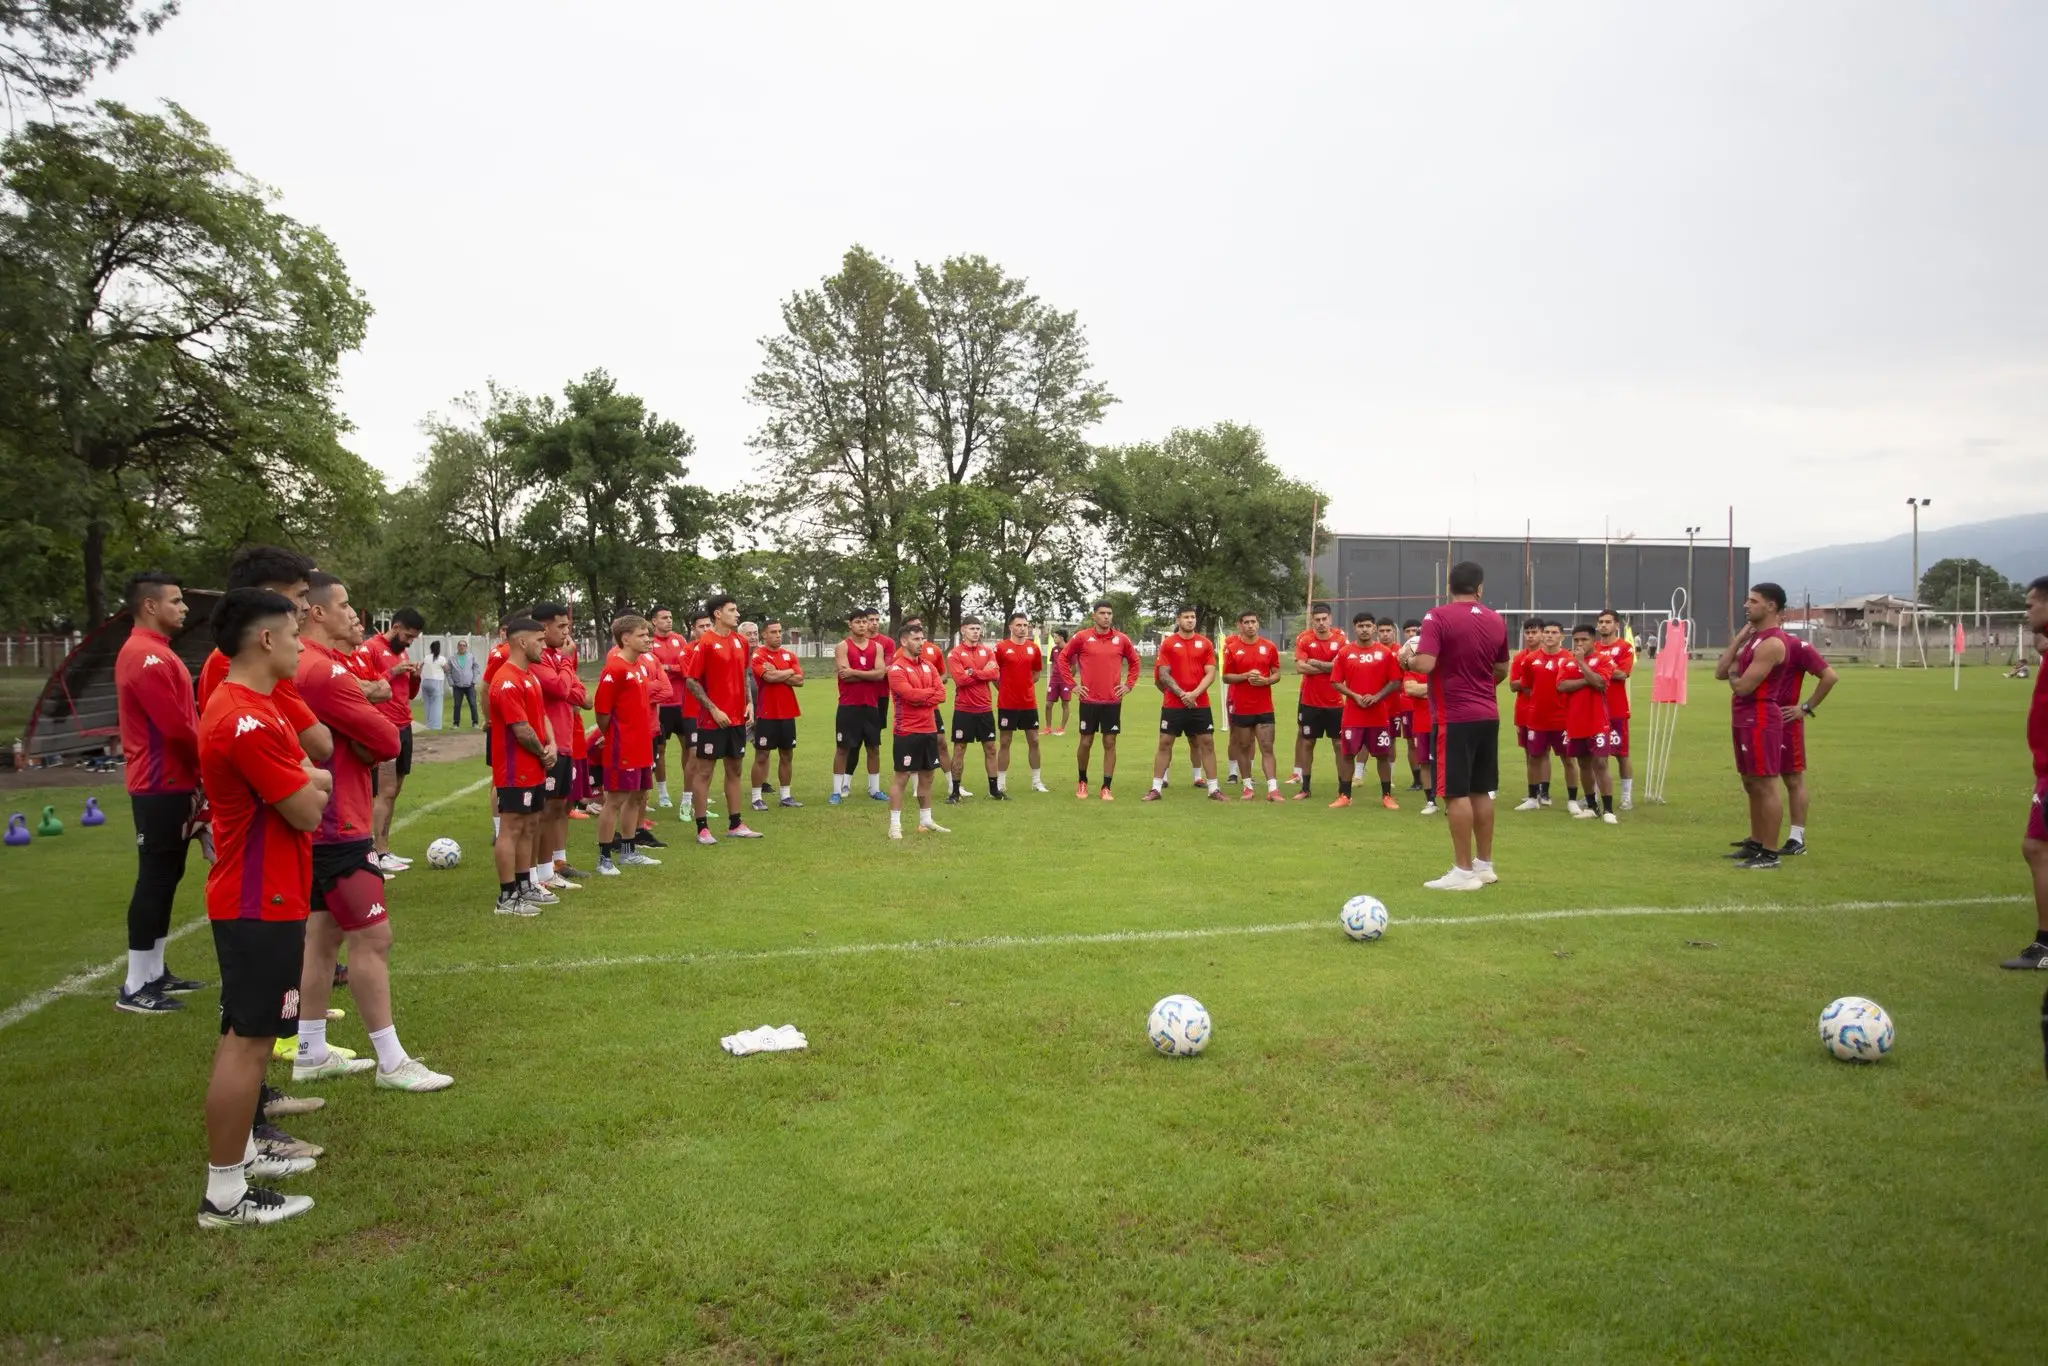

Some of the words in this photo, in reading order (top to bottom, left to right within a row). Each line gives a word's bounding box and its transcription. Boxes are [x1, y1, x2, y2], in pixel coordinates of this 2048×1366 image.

[1359, 653, 1373, 663] 30
[1545, 660, 1553, 670] 4
[1394, 721, 1401, 731] 7
[1377, 736, 1390, 747] 30
[1596, 736, 1605, 748] 9
[132, 996, 156, 1008] FILA
